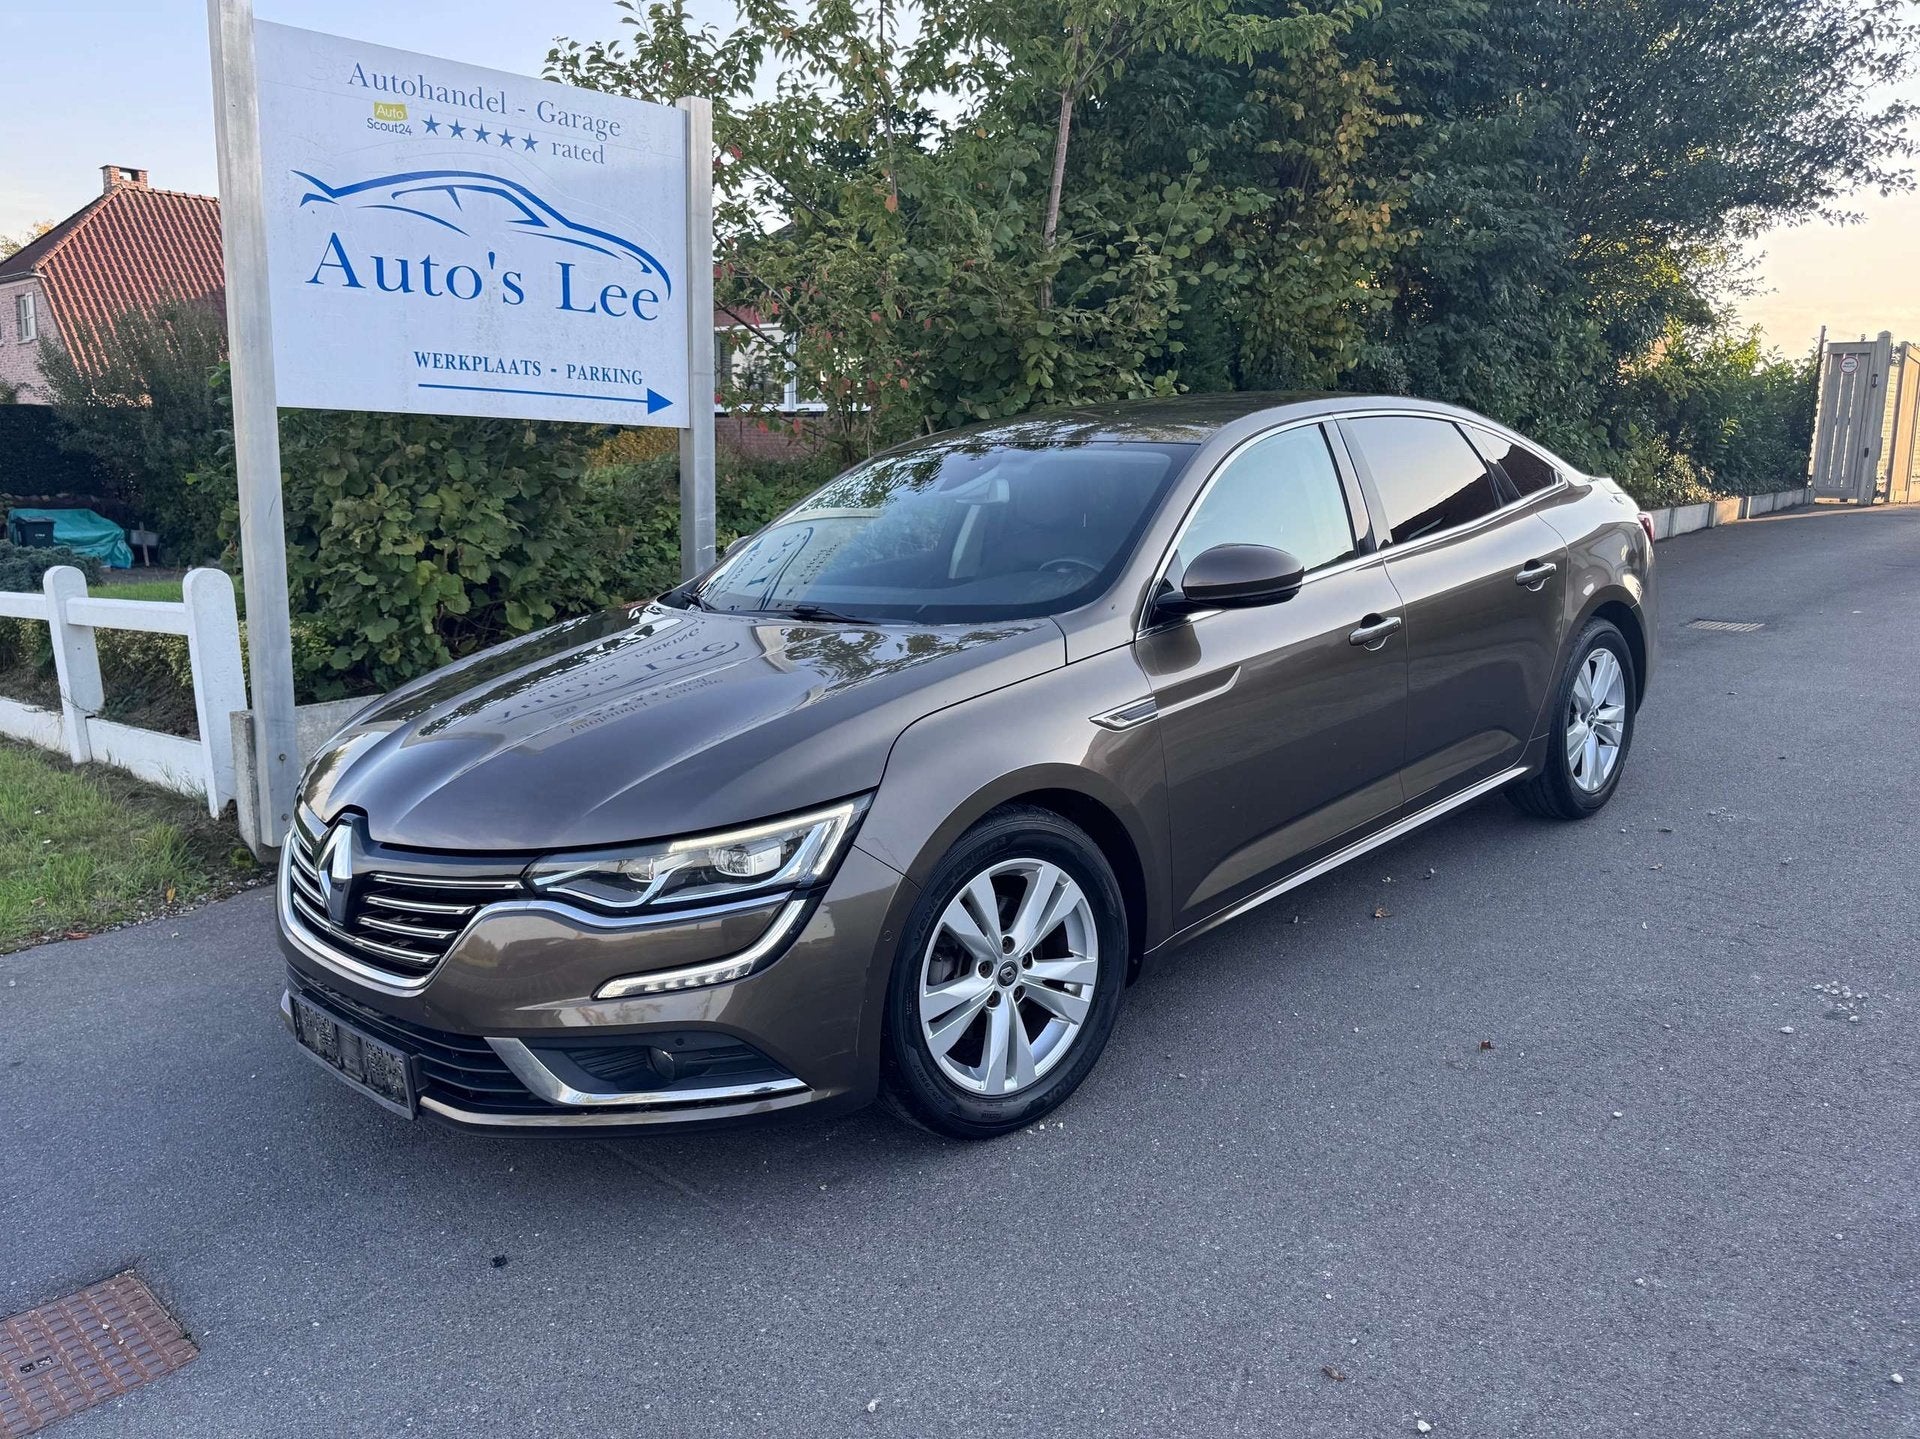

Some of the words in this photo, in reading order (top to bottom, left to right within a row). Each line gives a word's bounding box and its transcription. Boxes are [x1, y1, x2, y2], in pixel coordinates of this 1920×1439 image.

[347, 62, 507, 114] Autohandel
[537, 100, 621, 142] Garage
[375, 104, 405, 120] Auto
[366, 117, 413, 136] Scout24
[552, 142, 604, 165] rated
[305, 232, 525, 306] Auto's
[555, 261, 660, 321] Lee
[413, 351, 542, 376] WERKPLAATS
[566, 363, 644, 386] PARKING
